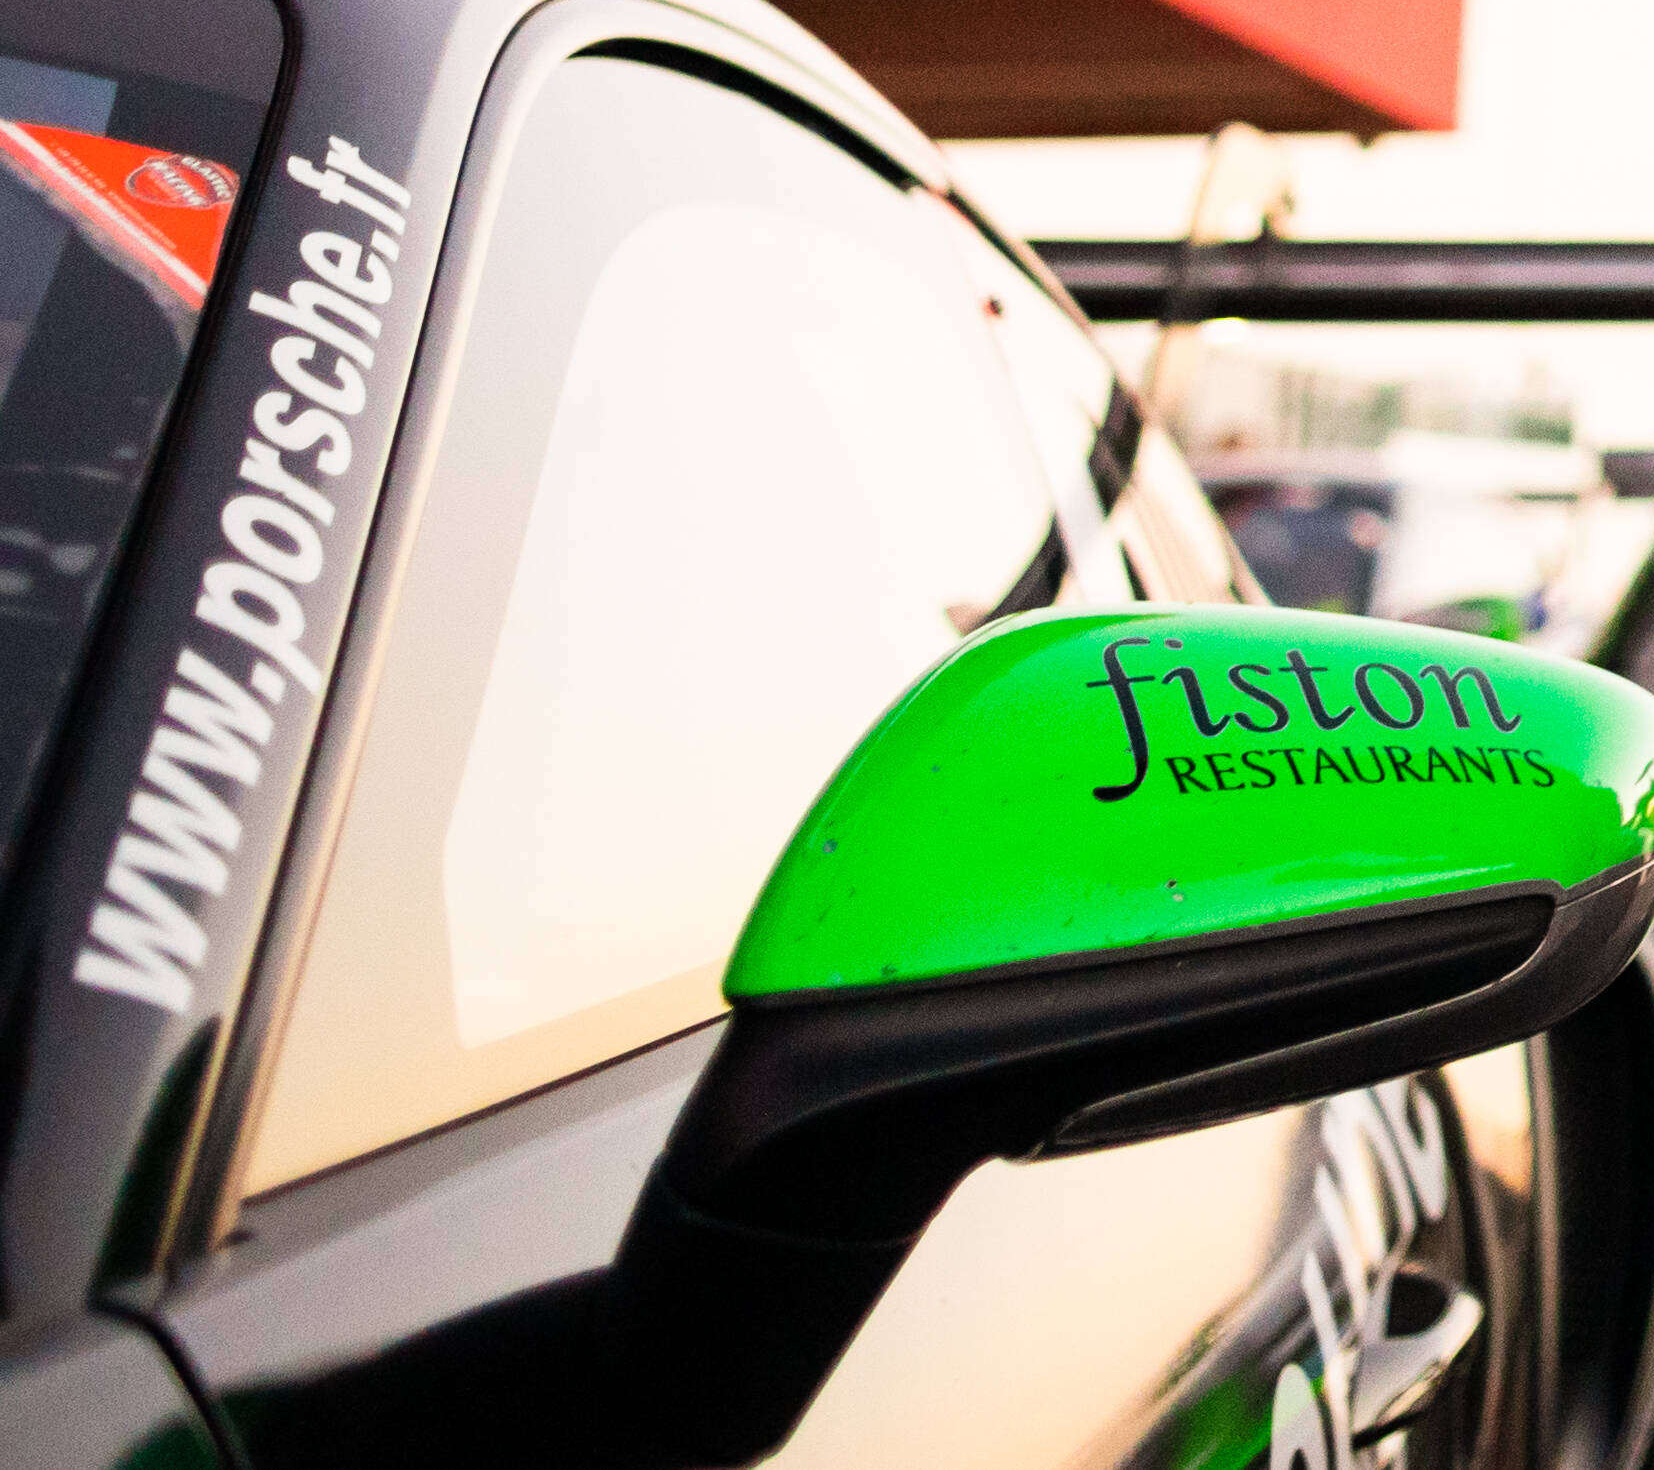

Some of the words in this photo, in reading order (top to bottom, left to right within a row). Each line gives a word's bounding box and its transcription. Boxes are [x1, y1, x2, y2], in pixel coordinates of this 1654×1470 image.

[72, 133, 412, 1017] www.porsche.fr
[1085, 637, 1523, 803] fiston
[1165, 745, 1558, 796] RESTAURANTS
